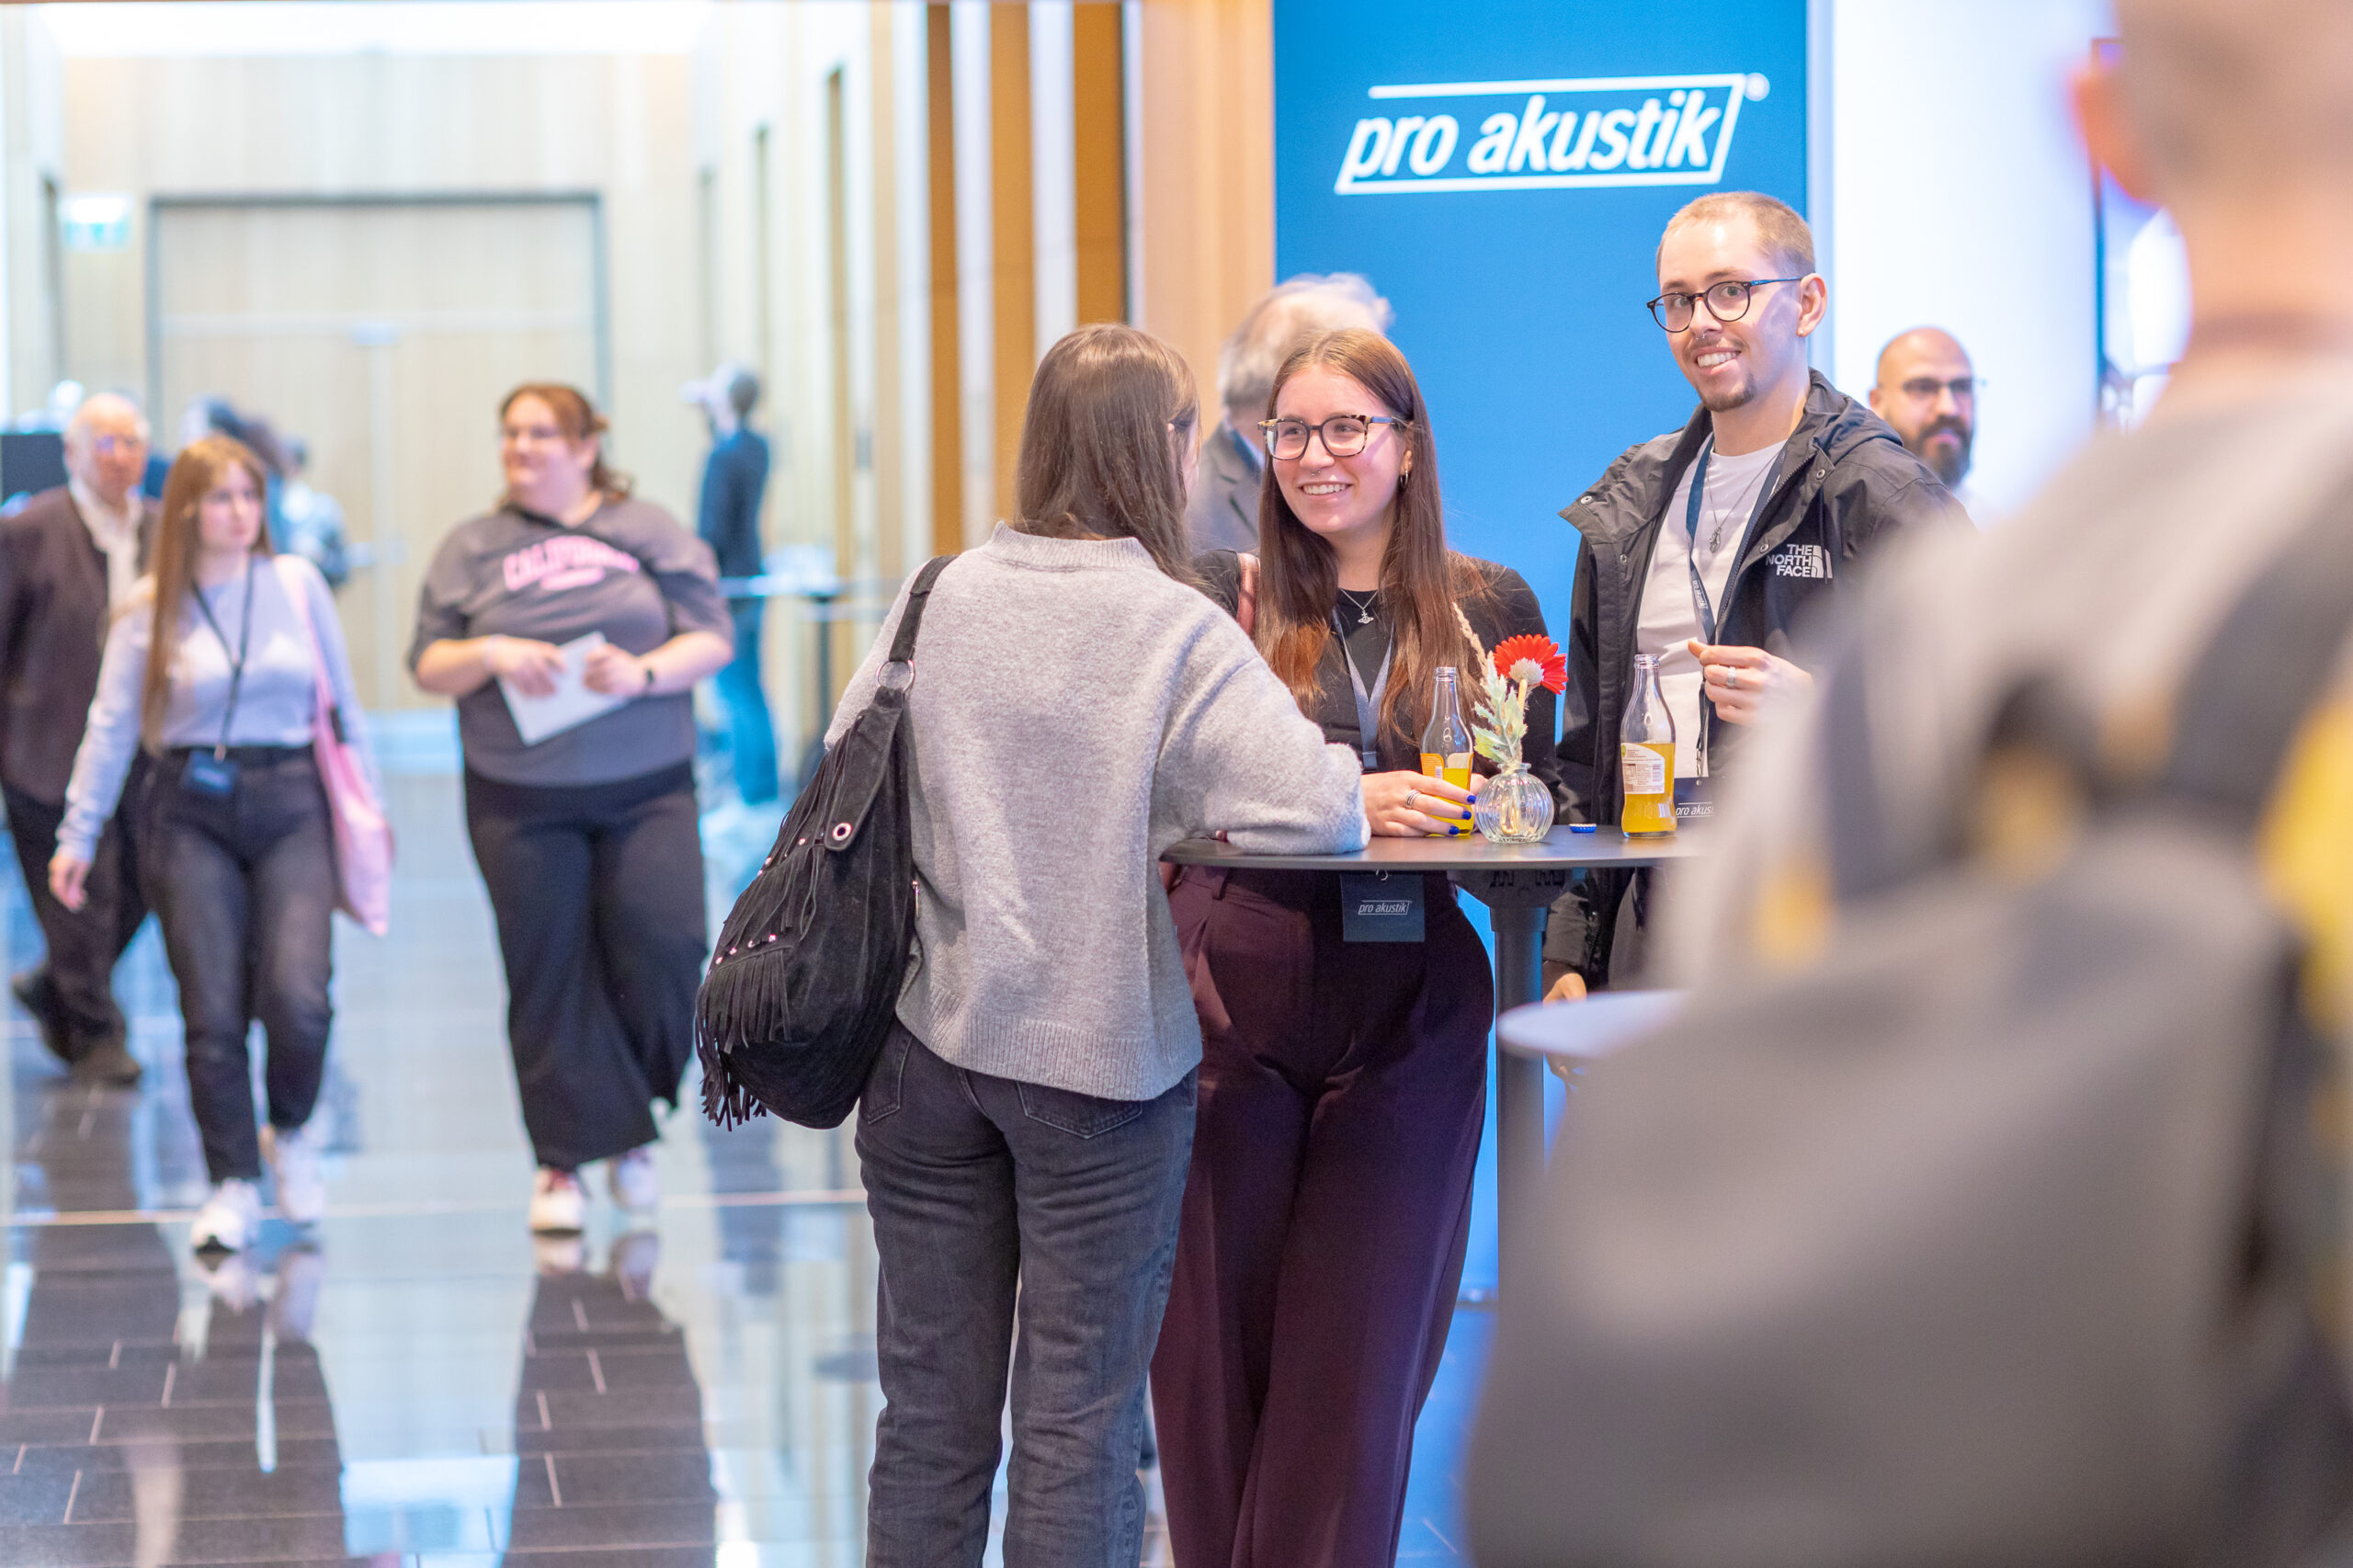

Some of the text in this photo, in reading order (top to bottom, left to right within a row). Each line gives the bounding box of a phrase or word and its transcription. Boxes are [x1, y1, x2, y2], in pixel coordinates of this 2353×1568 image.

[1340, 89, 1722, 187] pro akustik
[1787, 543, 1813, 556] THE
[1766, 554, 1812, 566] NORTH
[1776, 565, 1811, 577] FACE
[1358, 902, 1406, 914] pro akustik
